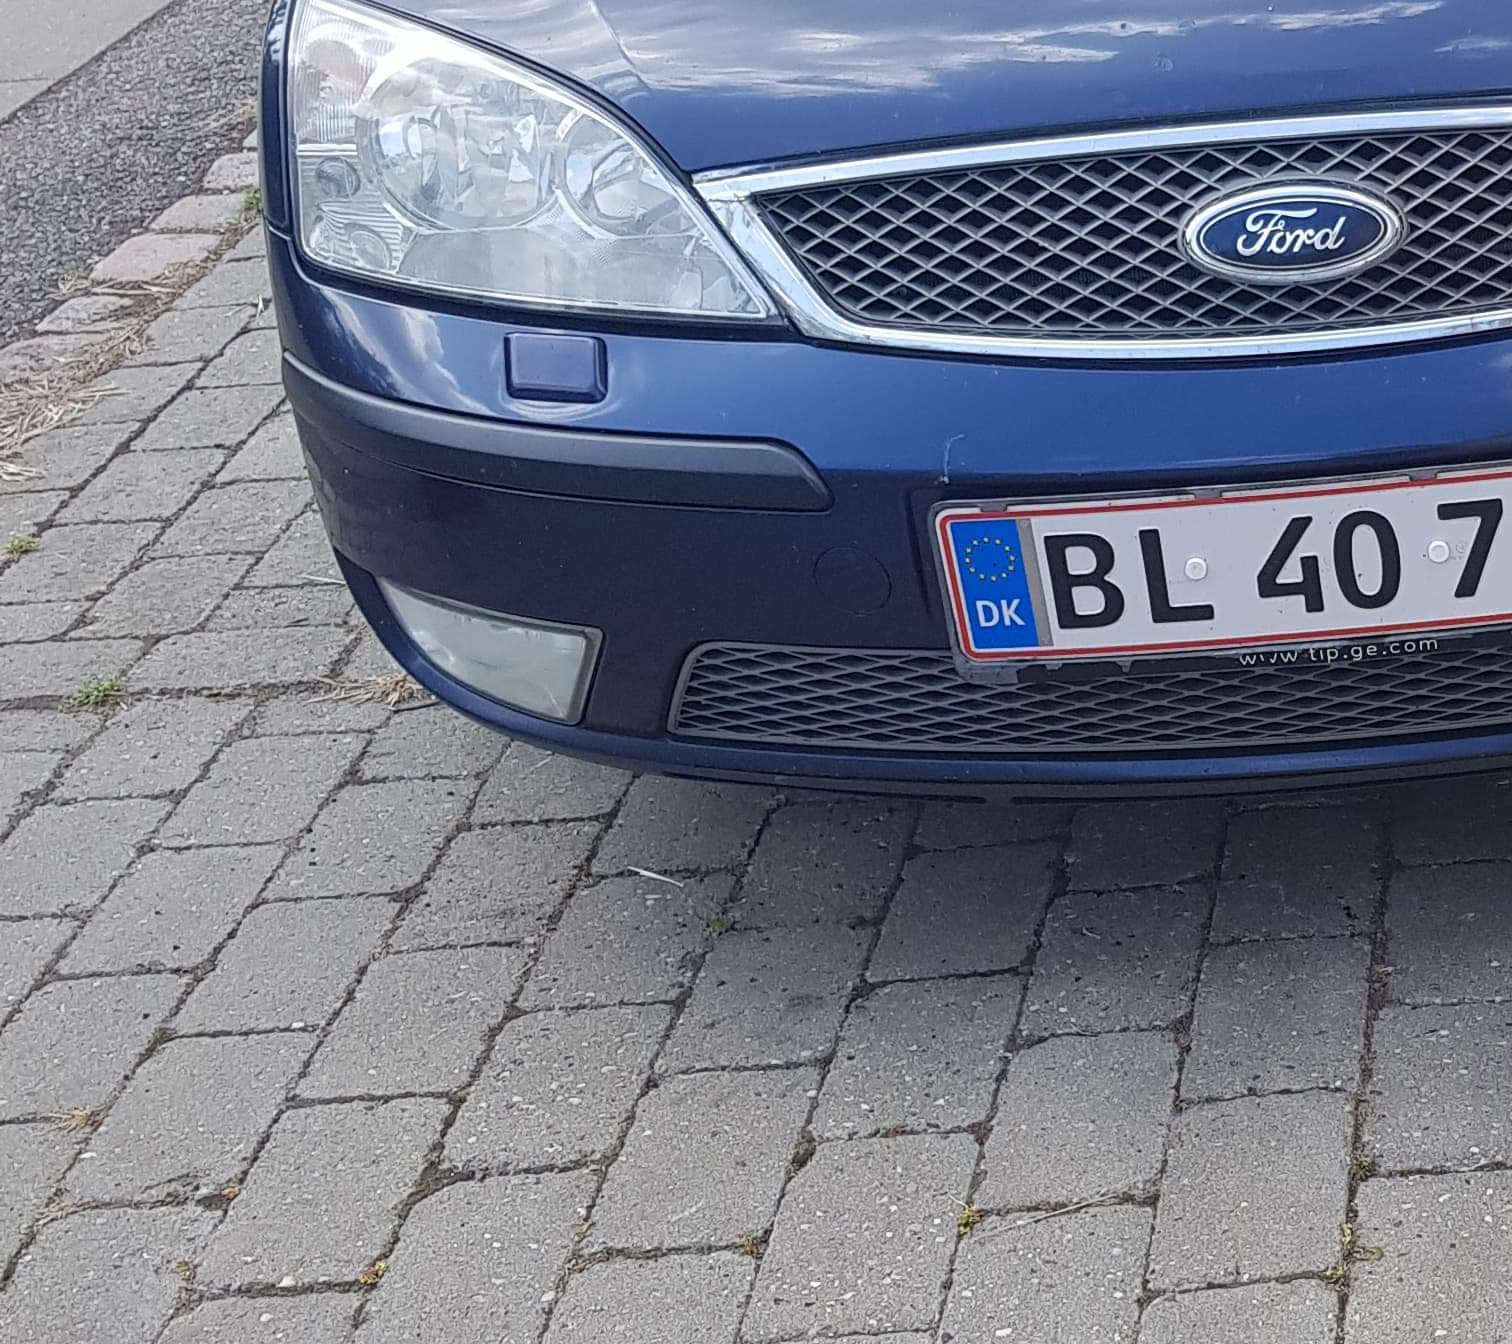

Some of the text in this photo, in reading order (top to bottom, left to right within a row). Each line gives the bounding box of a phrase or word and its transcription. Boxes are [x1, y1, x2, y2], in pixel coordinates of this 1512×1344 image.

[1236, 207, 1346, 257] Ford
[1043, 528, 1214, 629] BL
[1256, 510, 1401, 613] 40
[975, 598, 1025, 628] DK
[1239, 639, 1438, 665] wwwtip.ge.com
